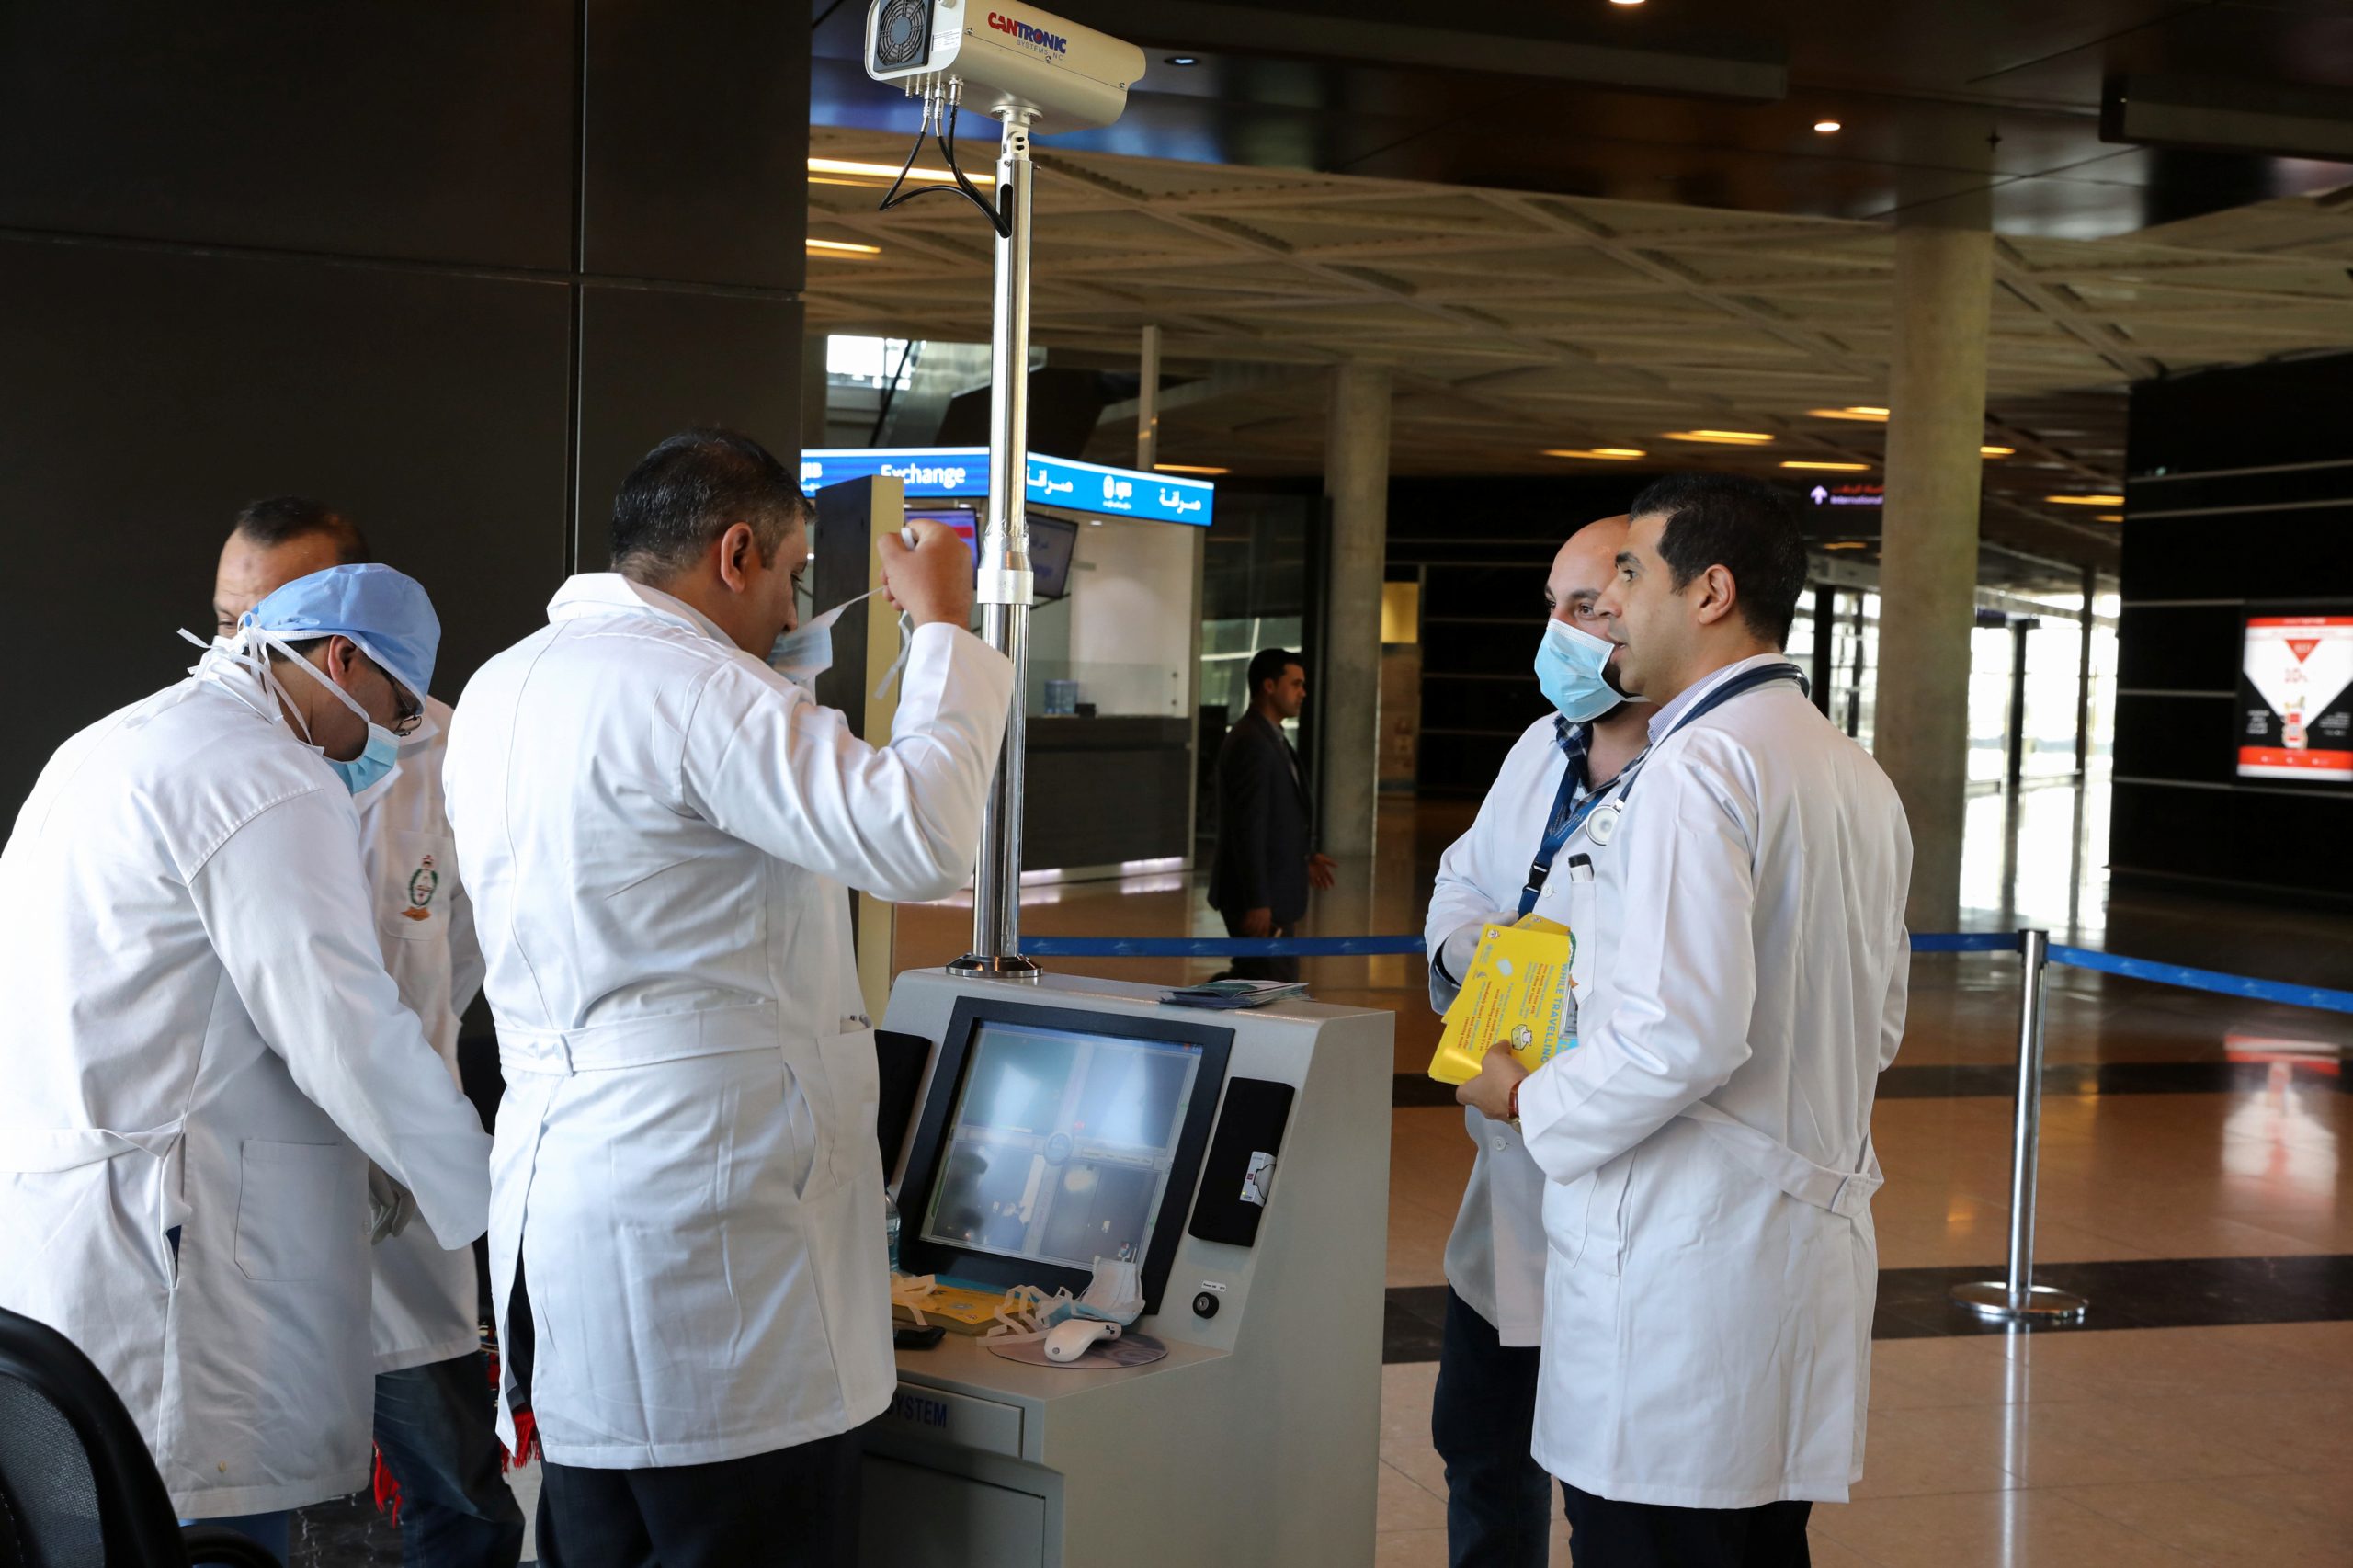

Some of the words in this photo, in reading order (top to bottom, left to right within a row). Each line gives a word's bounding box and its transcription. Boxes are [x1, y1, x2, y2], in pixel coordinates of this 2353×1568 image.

[988, 11, 1066, 54] CANTRONIC
[881, 462, 966, 489] Exchange
[1556, 962, 1568, 994] WHILE
[1540, 998, 1562, 1062] TRAVELLING
[888, 1393, 948, 1428] YSTEM
